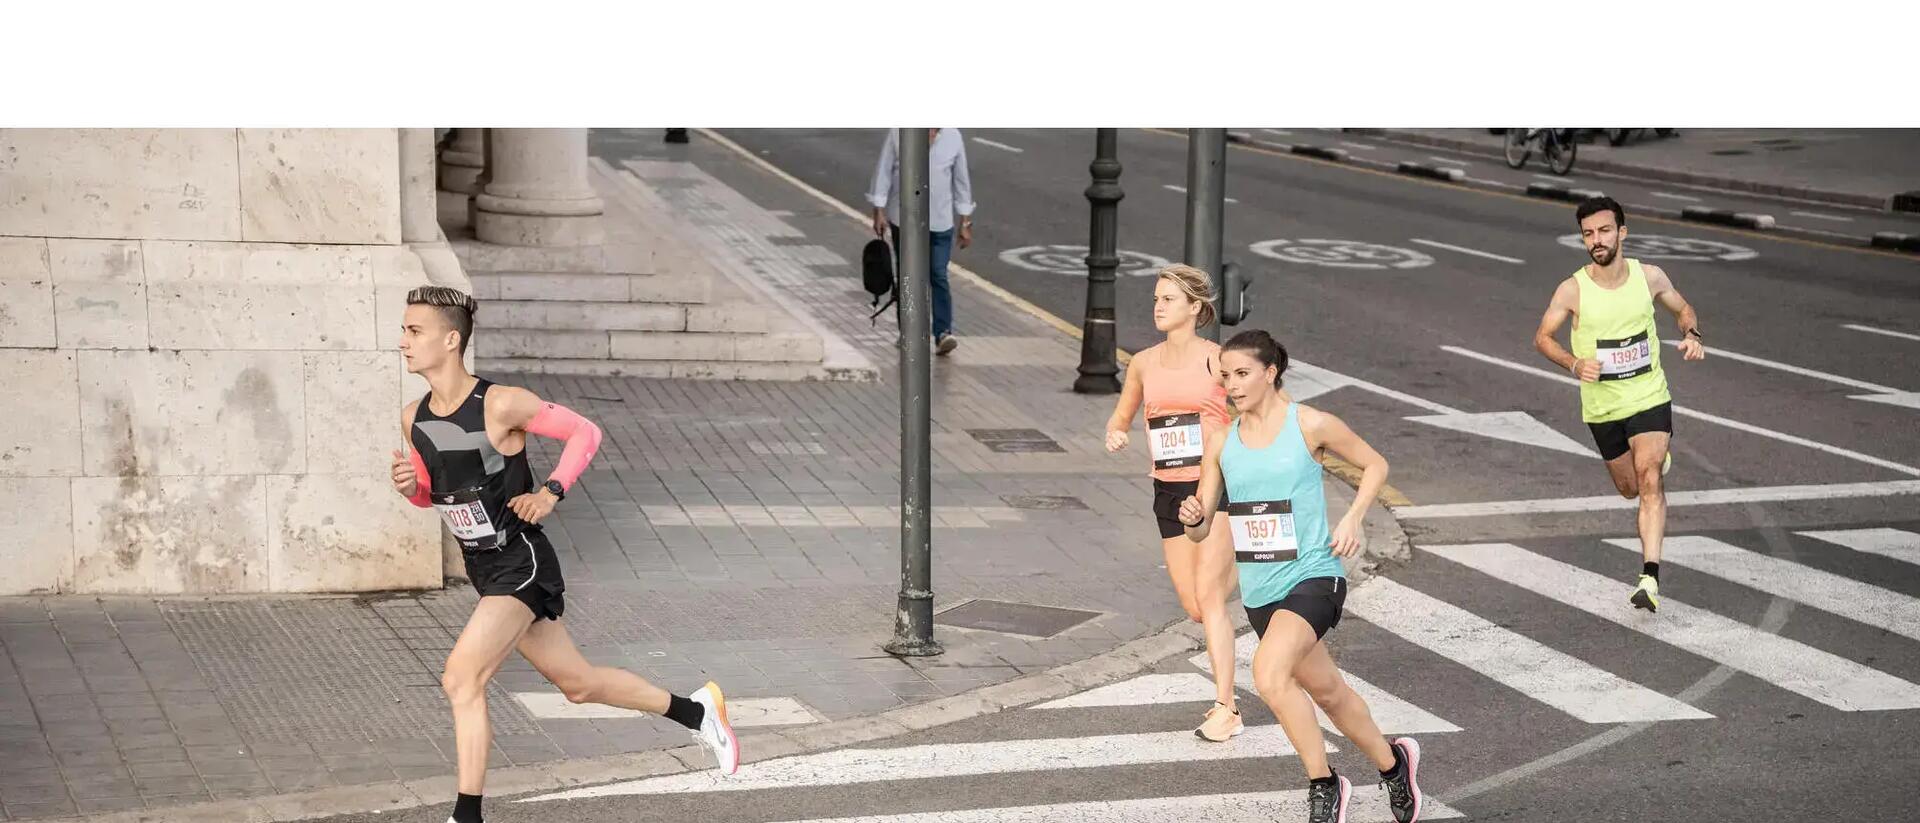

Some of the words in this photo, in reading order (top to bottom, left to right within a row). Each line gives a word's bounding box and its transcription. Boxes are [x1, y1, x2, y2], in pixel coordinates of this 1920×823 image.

[1611, 347, 1638, 365] 1392
[1160, 430, 1186, 449] 1204
[474, 512, 485, 522] 30
[1244, 519, 1277, 539] 1597
